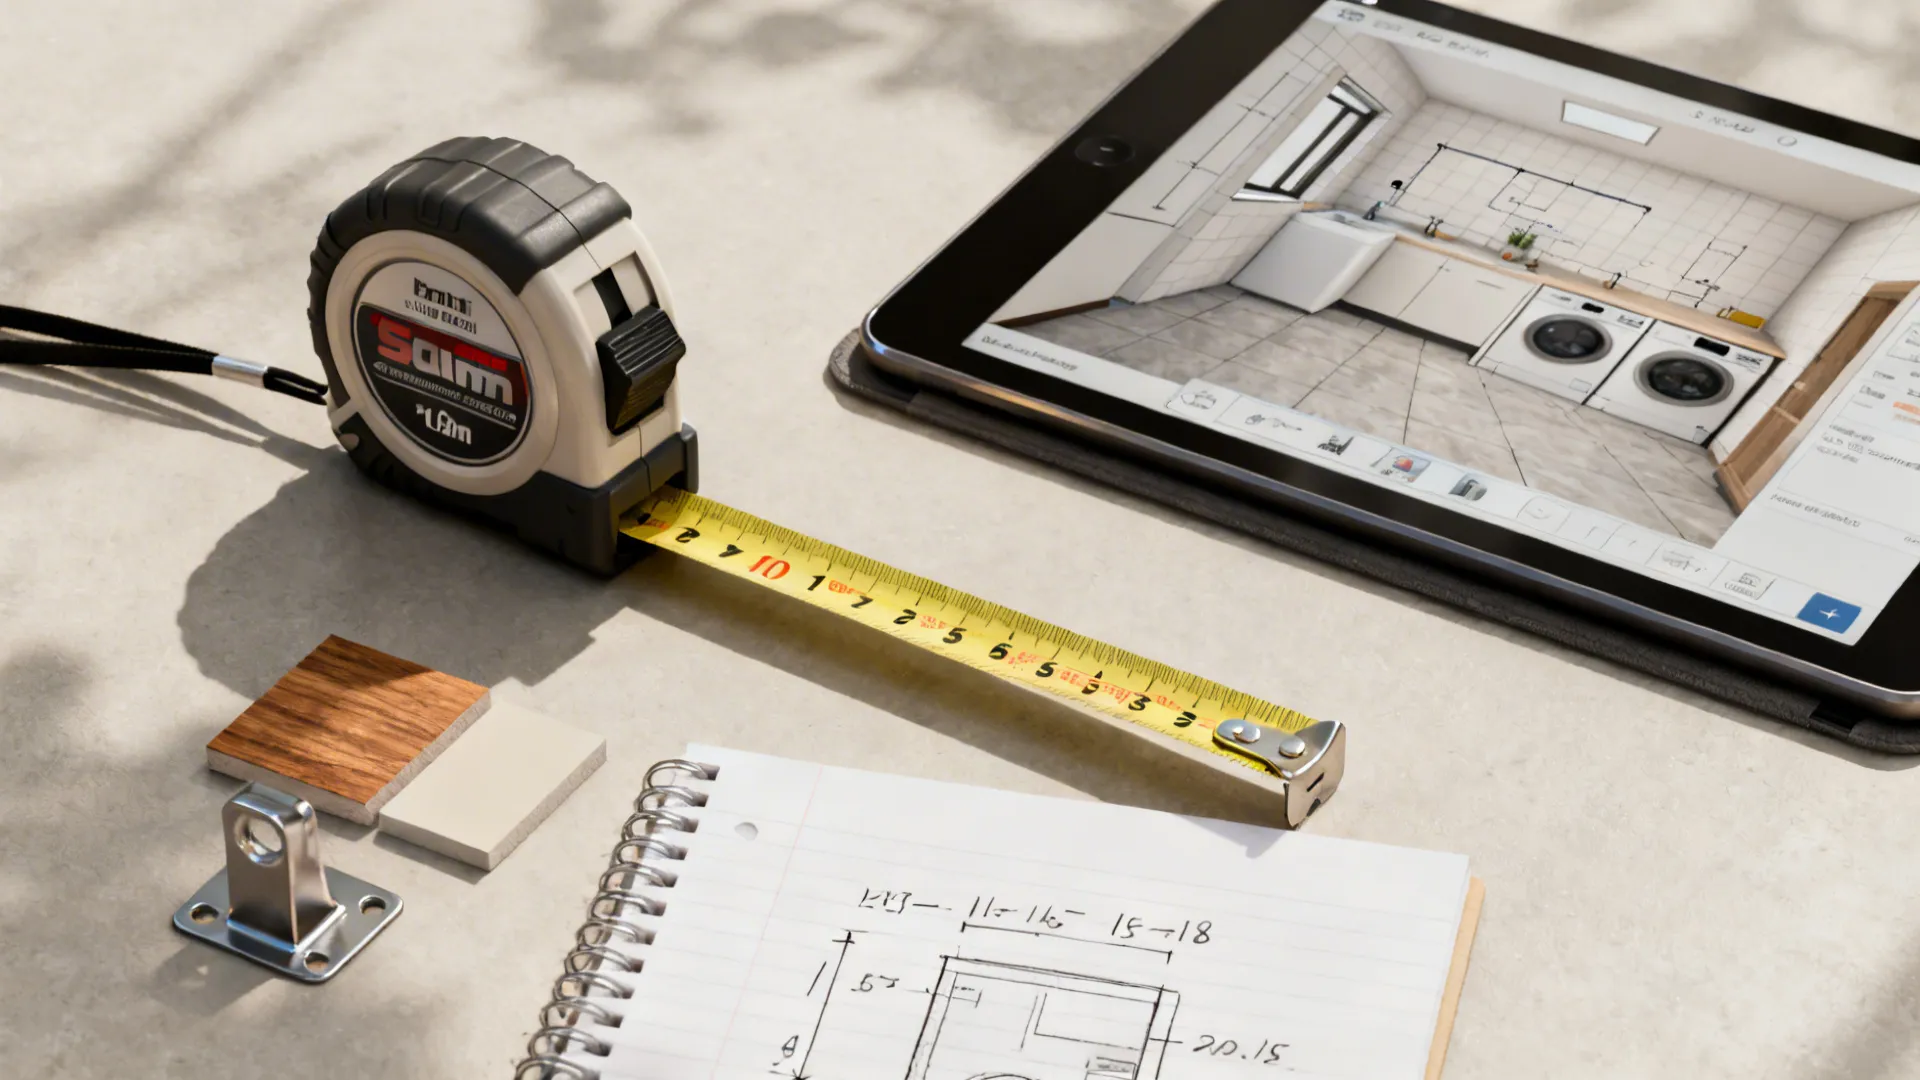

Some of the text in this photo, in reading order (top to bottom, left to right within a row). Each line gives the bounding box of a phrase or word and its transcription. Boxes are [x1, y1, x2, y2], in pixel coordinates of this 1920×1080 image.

[749, 555, 790, 580] 10
[807, 575, 826, 591] 1
[942, 627, 967, 644] 5
[1035, 661, 1058, 678] 5
